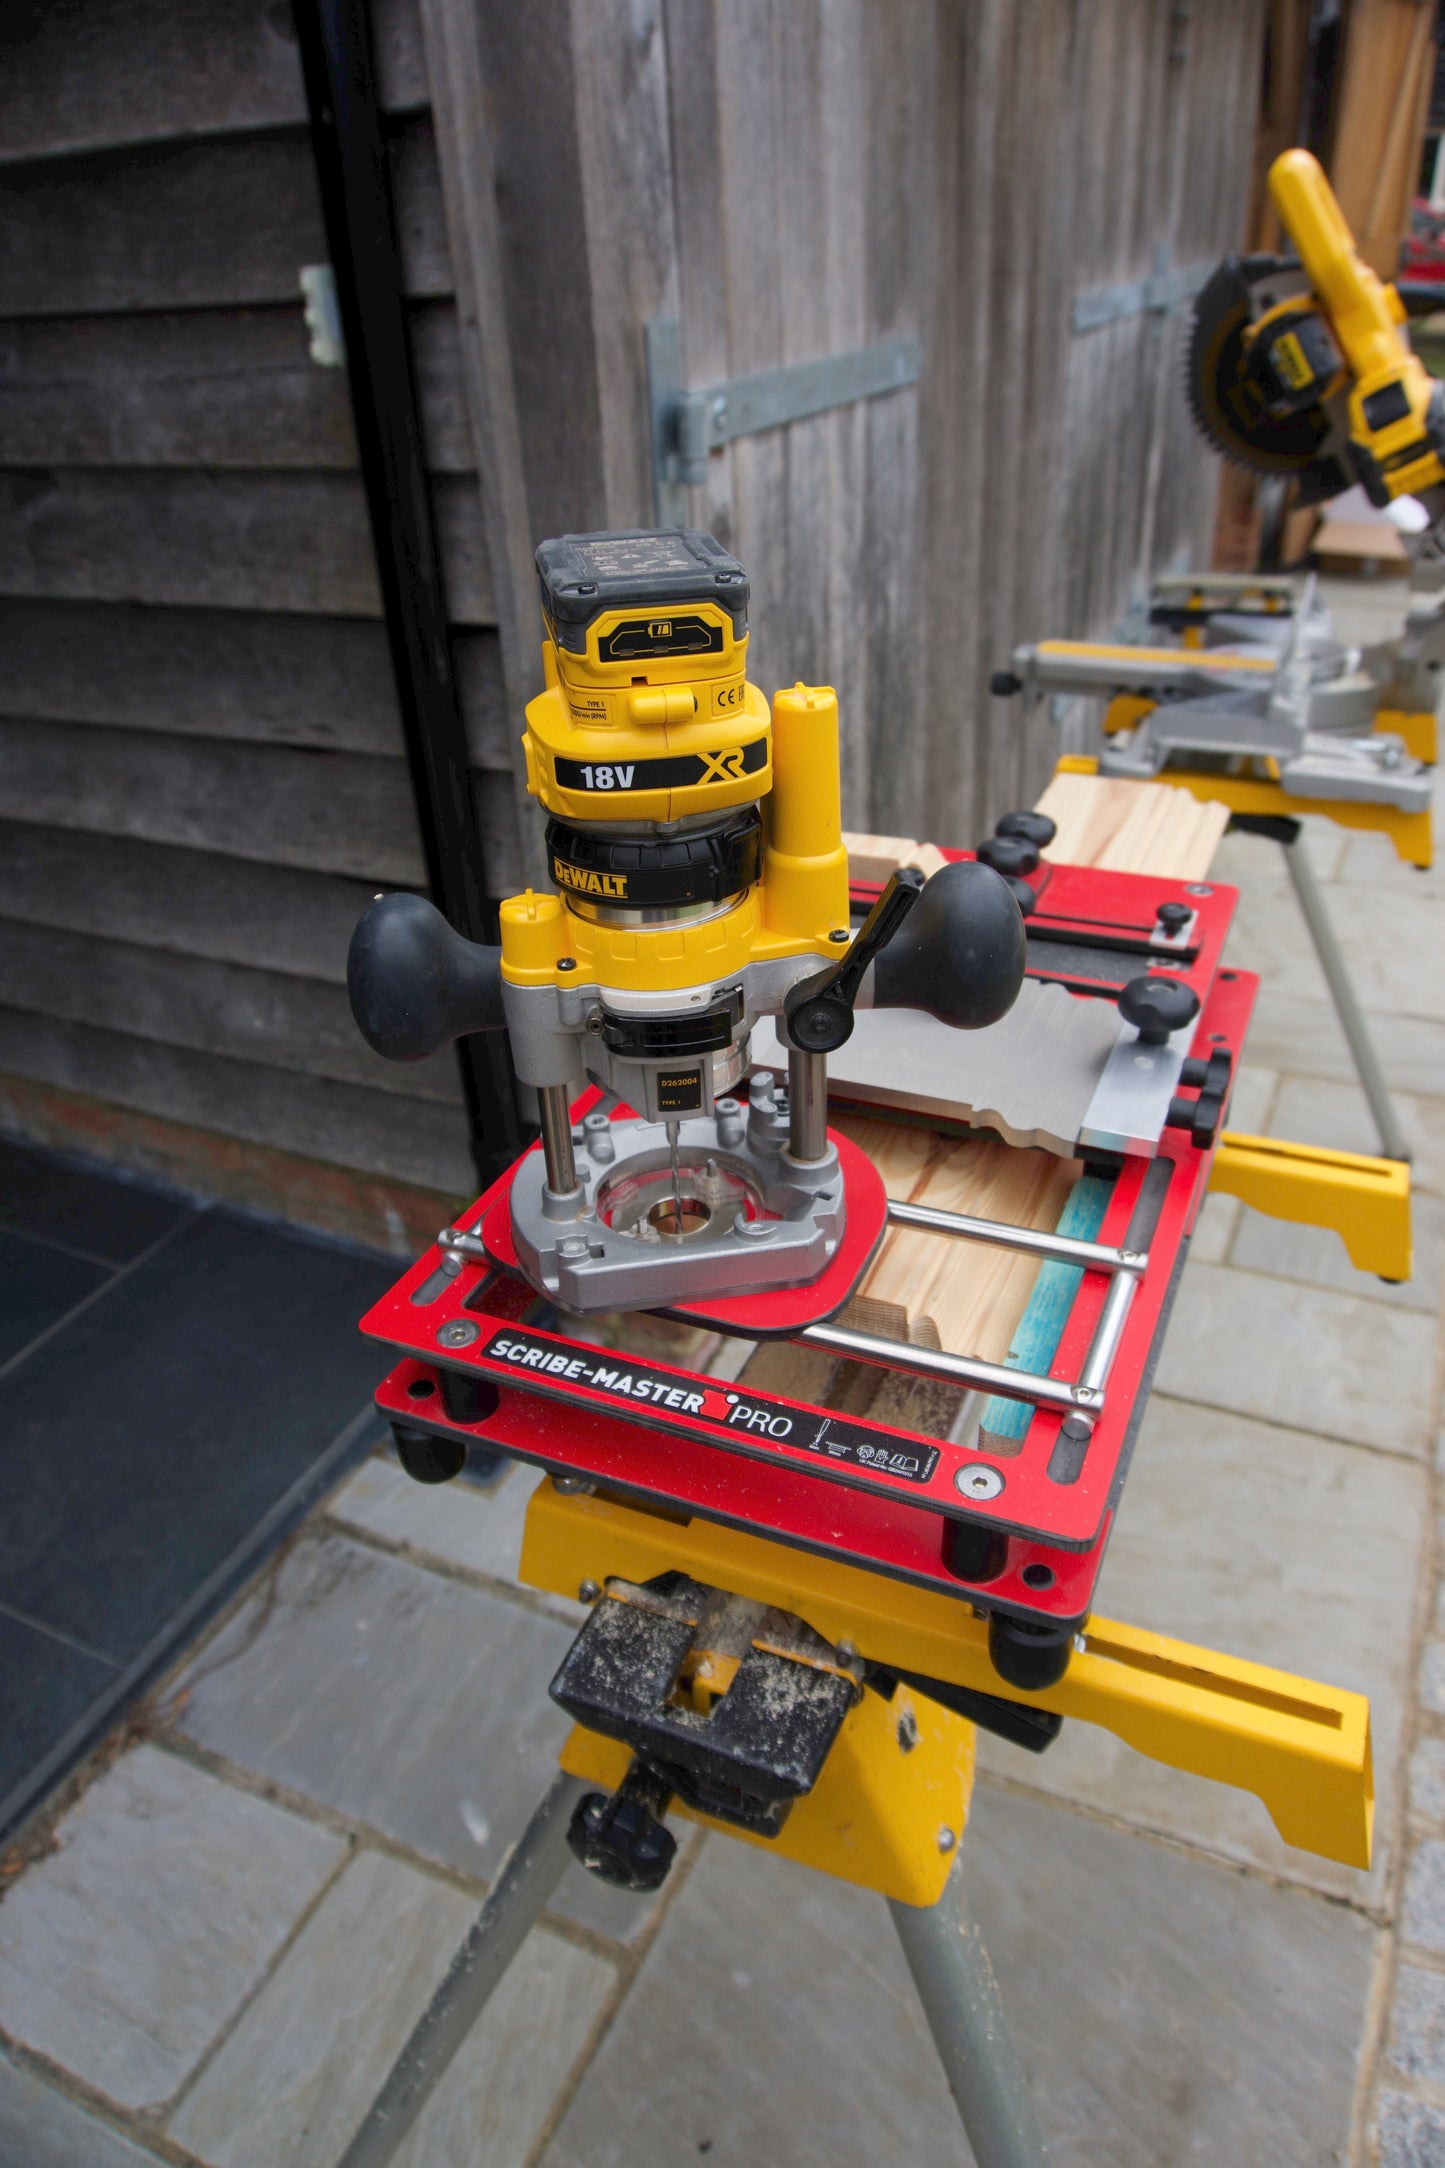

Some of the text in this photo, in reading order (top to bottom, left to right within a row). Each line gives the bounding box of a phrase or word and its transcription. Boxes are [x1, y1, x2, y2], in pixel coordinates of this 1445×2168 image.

[586, 700, 600, 708] TYPE
[580, 765, 635, 790] 18V
[697, 747, 745, 785] XR
[661, 1077, 697, 1087] D262004
[490, 1340, 704, 1414] SCRIBE-MASTER
[729, 1405, 793, 1438] PRO
